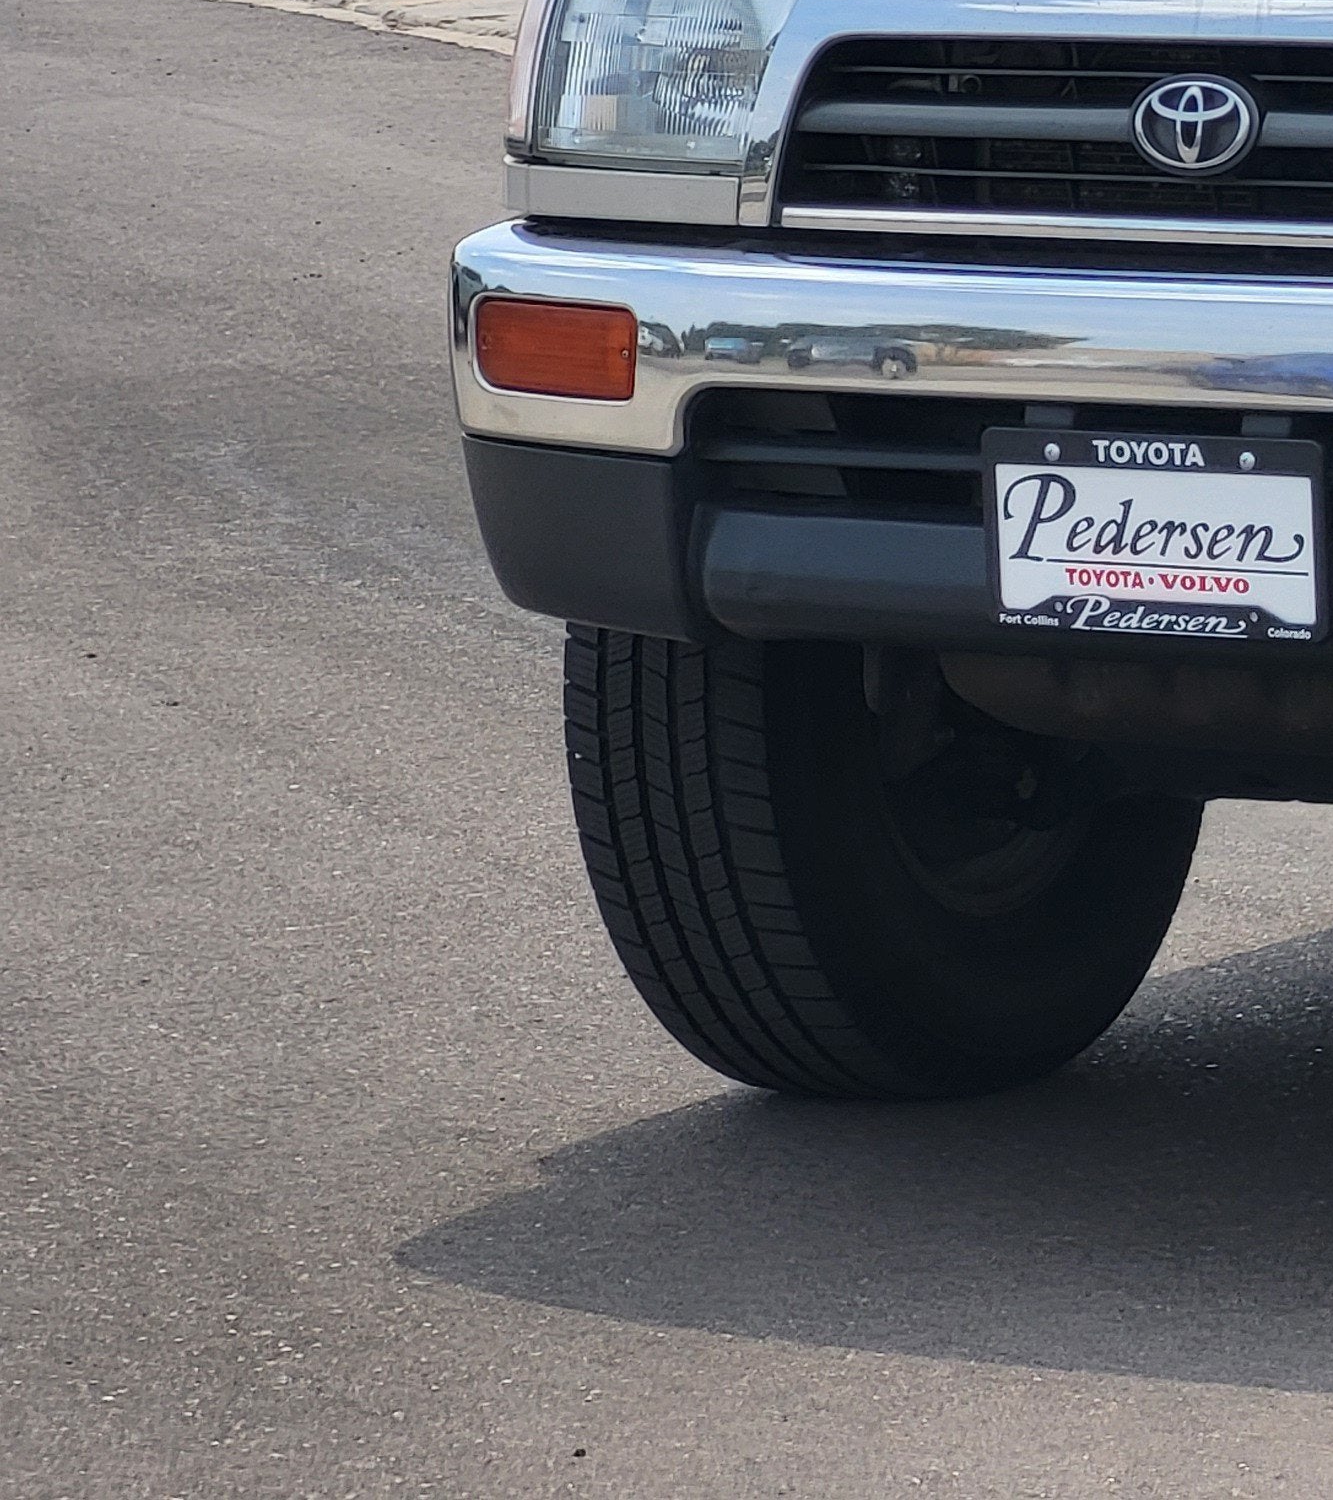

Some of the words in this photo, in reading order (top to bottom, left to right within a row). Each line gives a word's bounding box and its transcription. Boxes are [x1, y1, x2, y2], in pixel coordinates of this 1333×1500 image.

[1092, 439, 1205, 467] TOYOTA
[1003, 473, 1305, 563] Pedersen
[1065, 568, 1145, 589] TOYOTA
[1157, 573, 1250, 594] VOLVO
[999, 613, 1022, 626] Fort
[1023, 614, 1059, 628] Collins
[1066, 593, 1248, 635] Pedersen
[1267, 627, 1312, 641] Colorado
